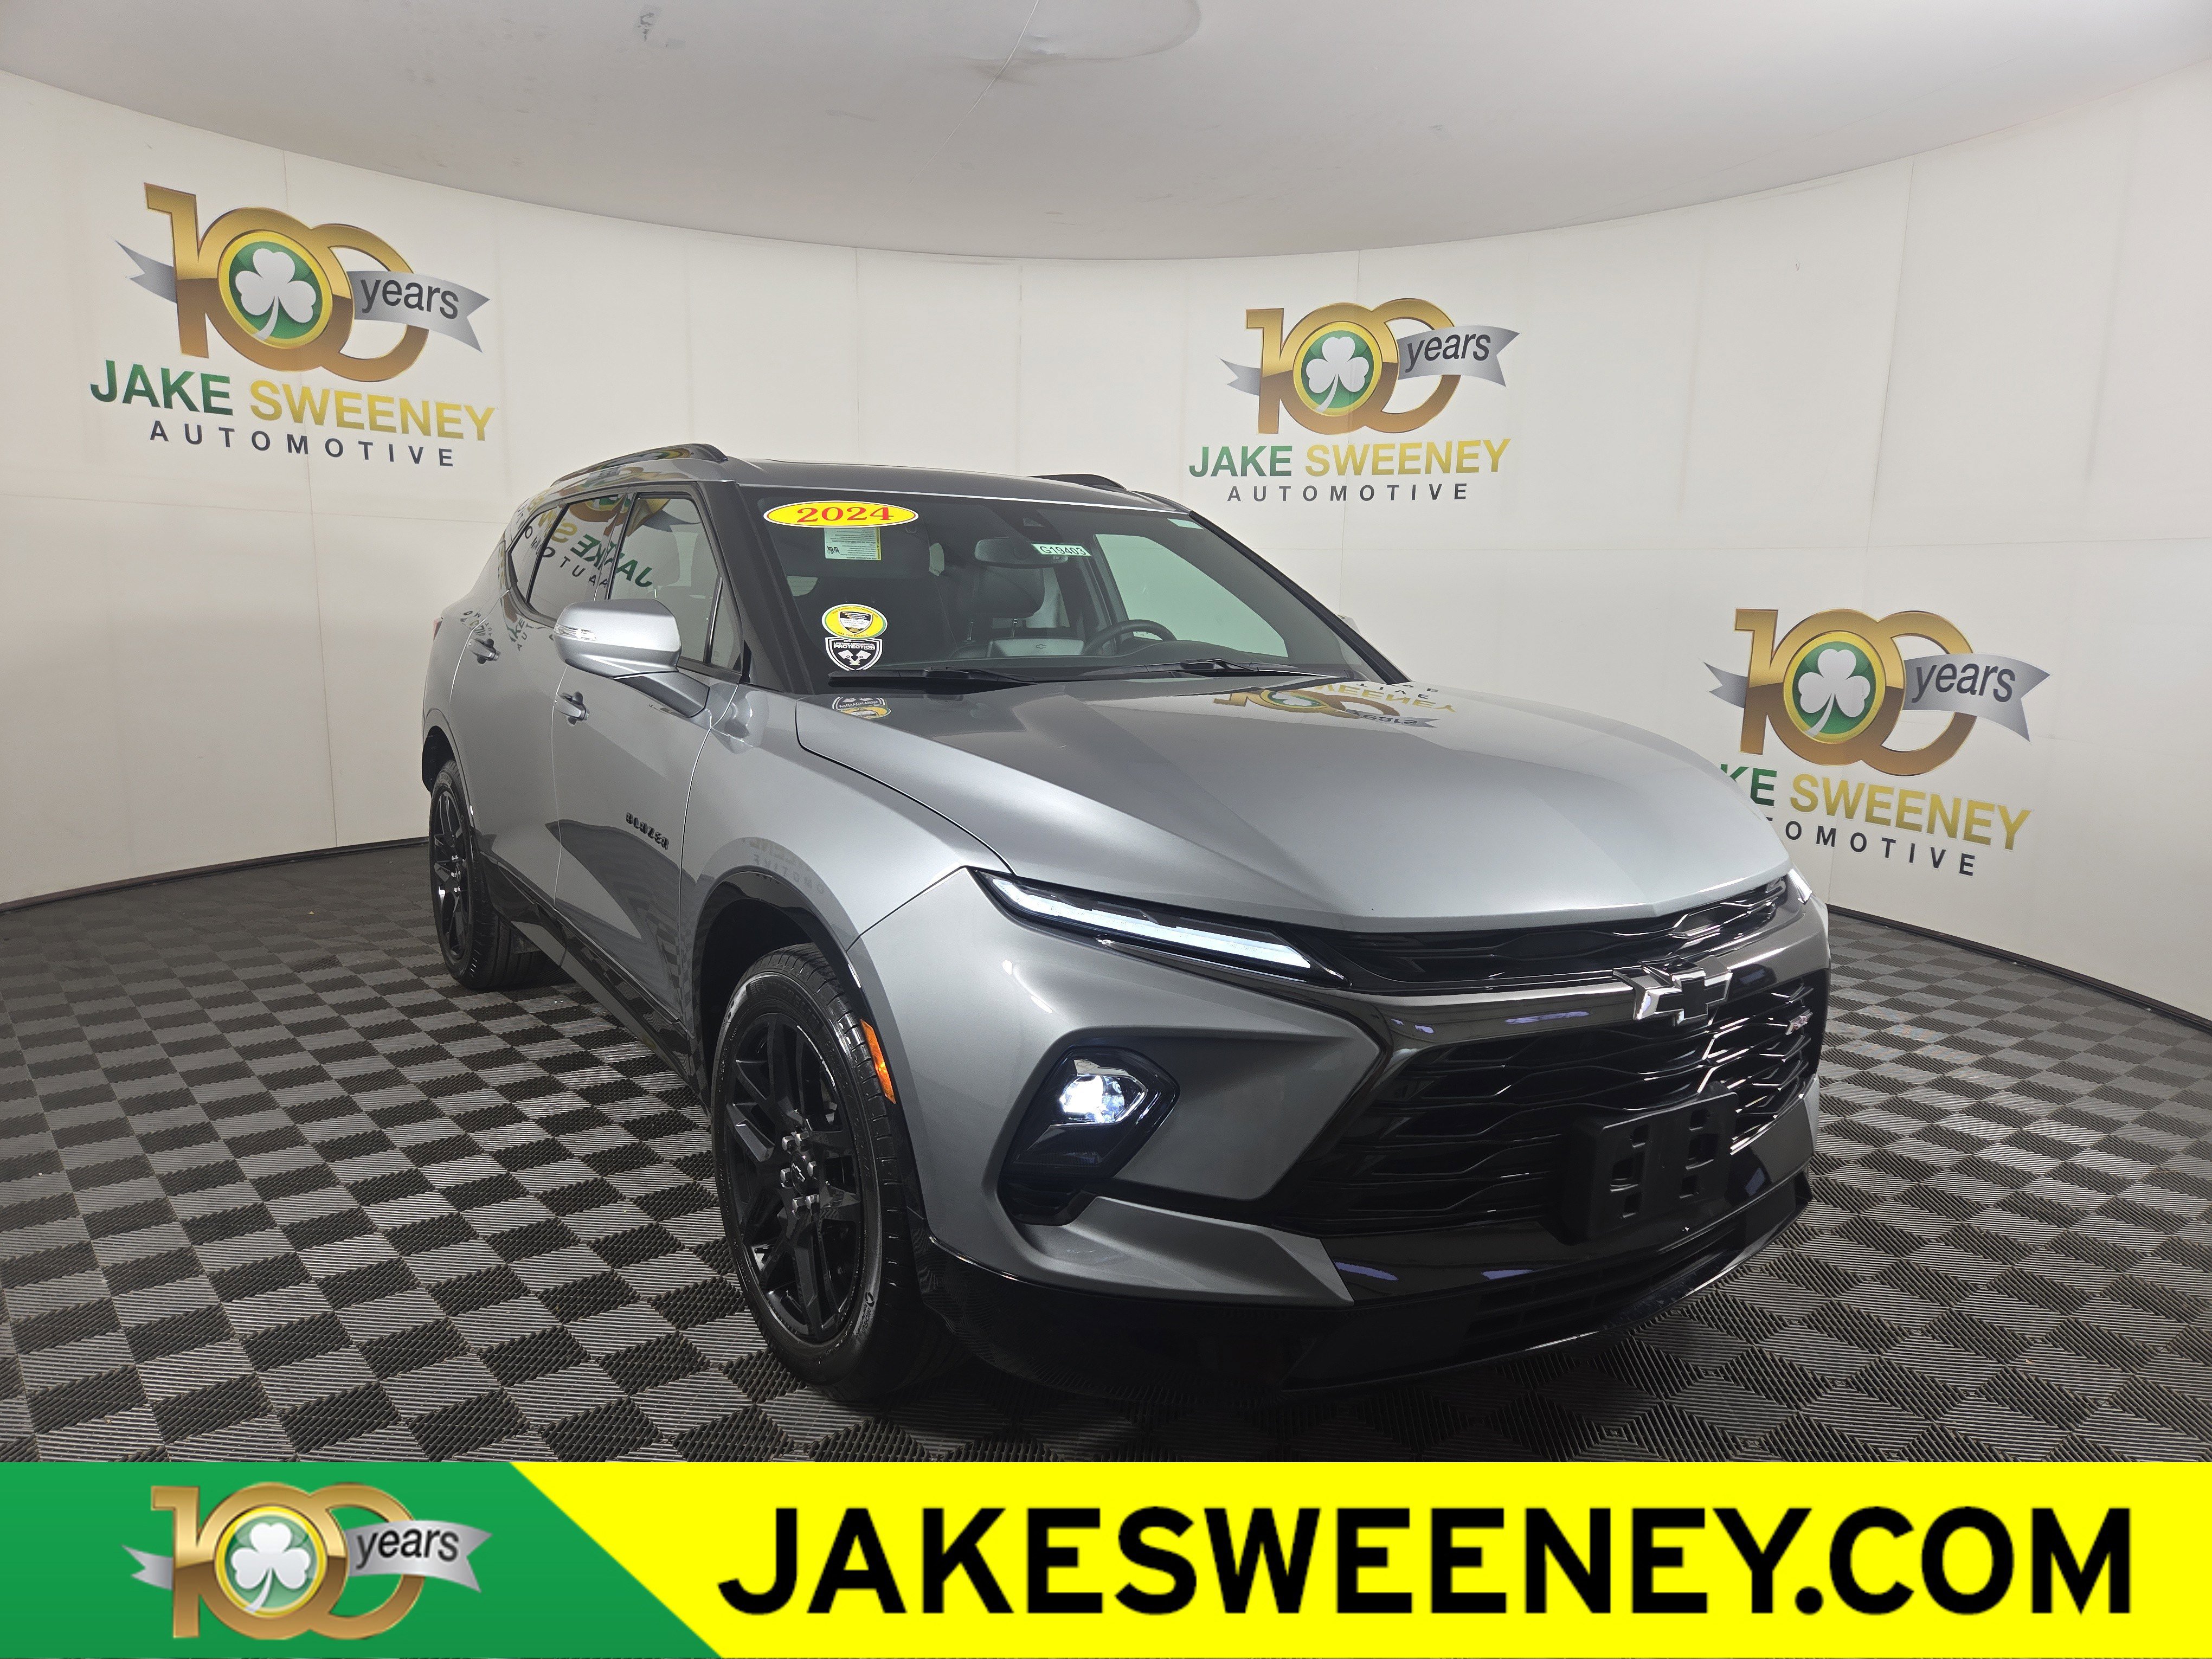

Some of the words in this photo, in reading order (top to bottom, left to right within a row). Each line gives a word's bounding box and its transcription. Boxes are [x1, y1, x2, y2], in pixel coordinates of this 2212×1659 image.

[361, 277, 459, 320] years
[1405, 333, 1491, 373] years
[90, 359, 234, 416] JAKE
[250, 380, 496, 441] SWEENEY
[150, 420, 454, 467] AUTOMOTIVE
[1189, 445, 1293, 477] JAKE
[1305, 439, 1511, 477] SWEENEY
[1227, 483, 1467, 501] AUTOMOTIVE
[797, 506, 894, 523] 2024
[1039, 546, 1086, 555] G19403
[1911, 663, 2015, 703] years
[1790, 774, 2032, 851] SWEENEY
[1766, 816, 1976, 877] OMOTIVE
